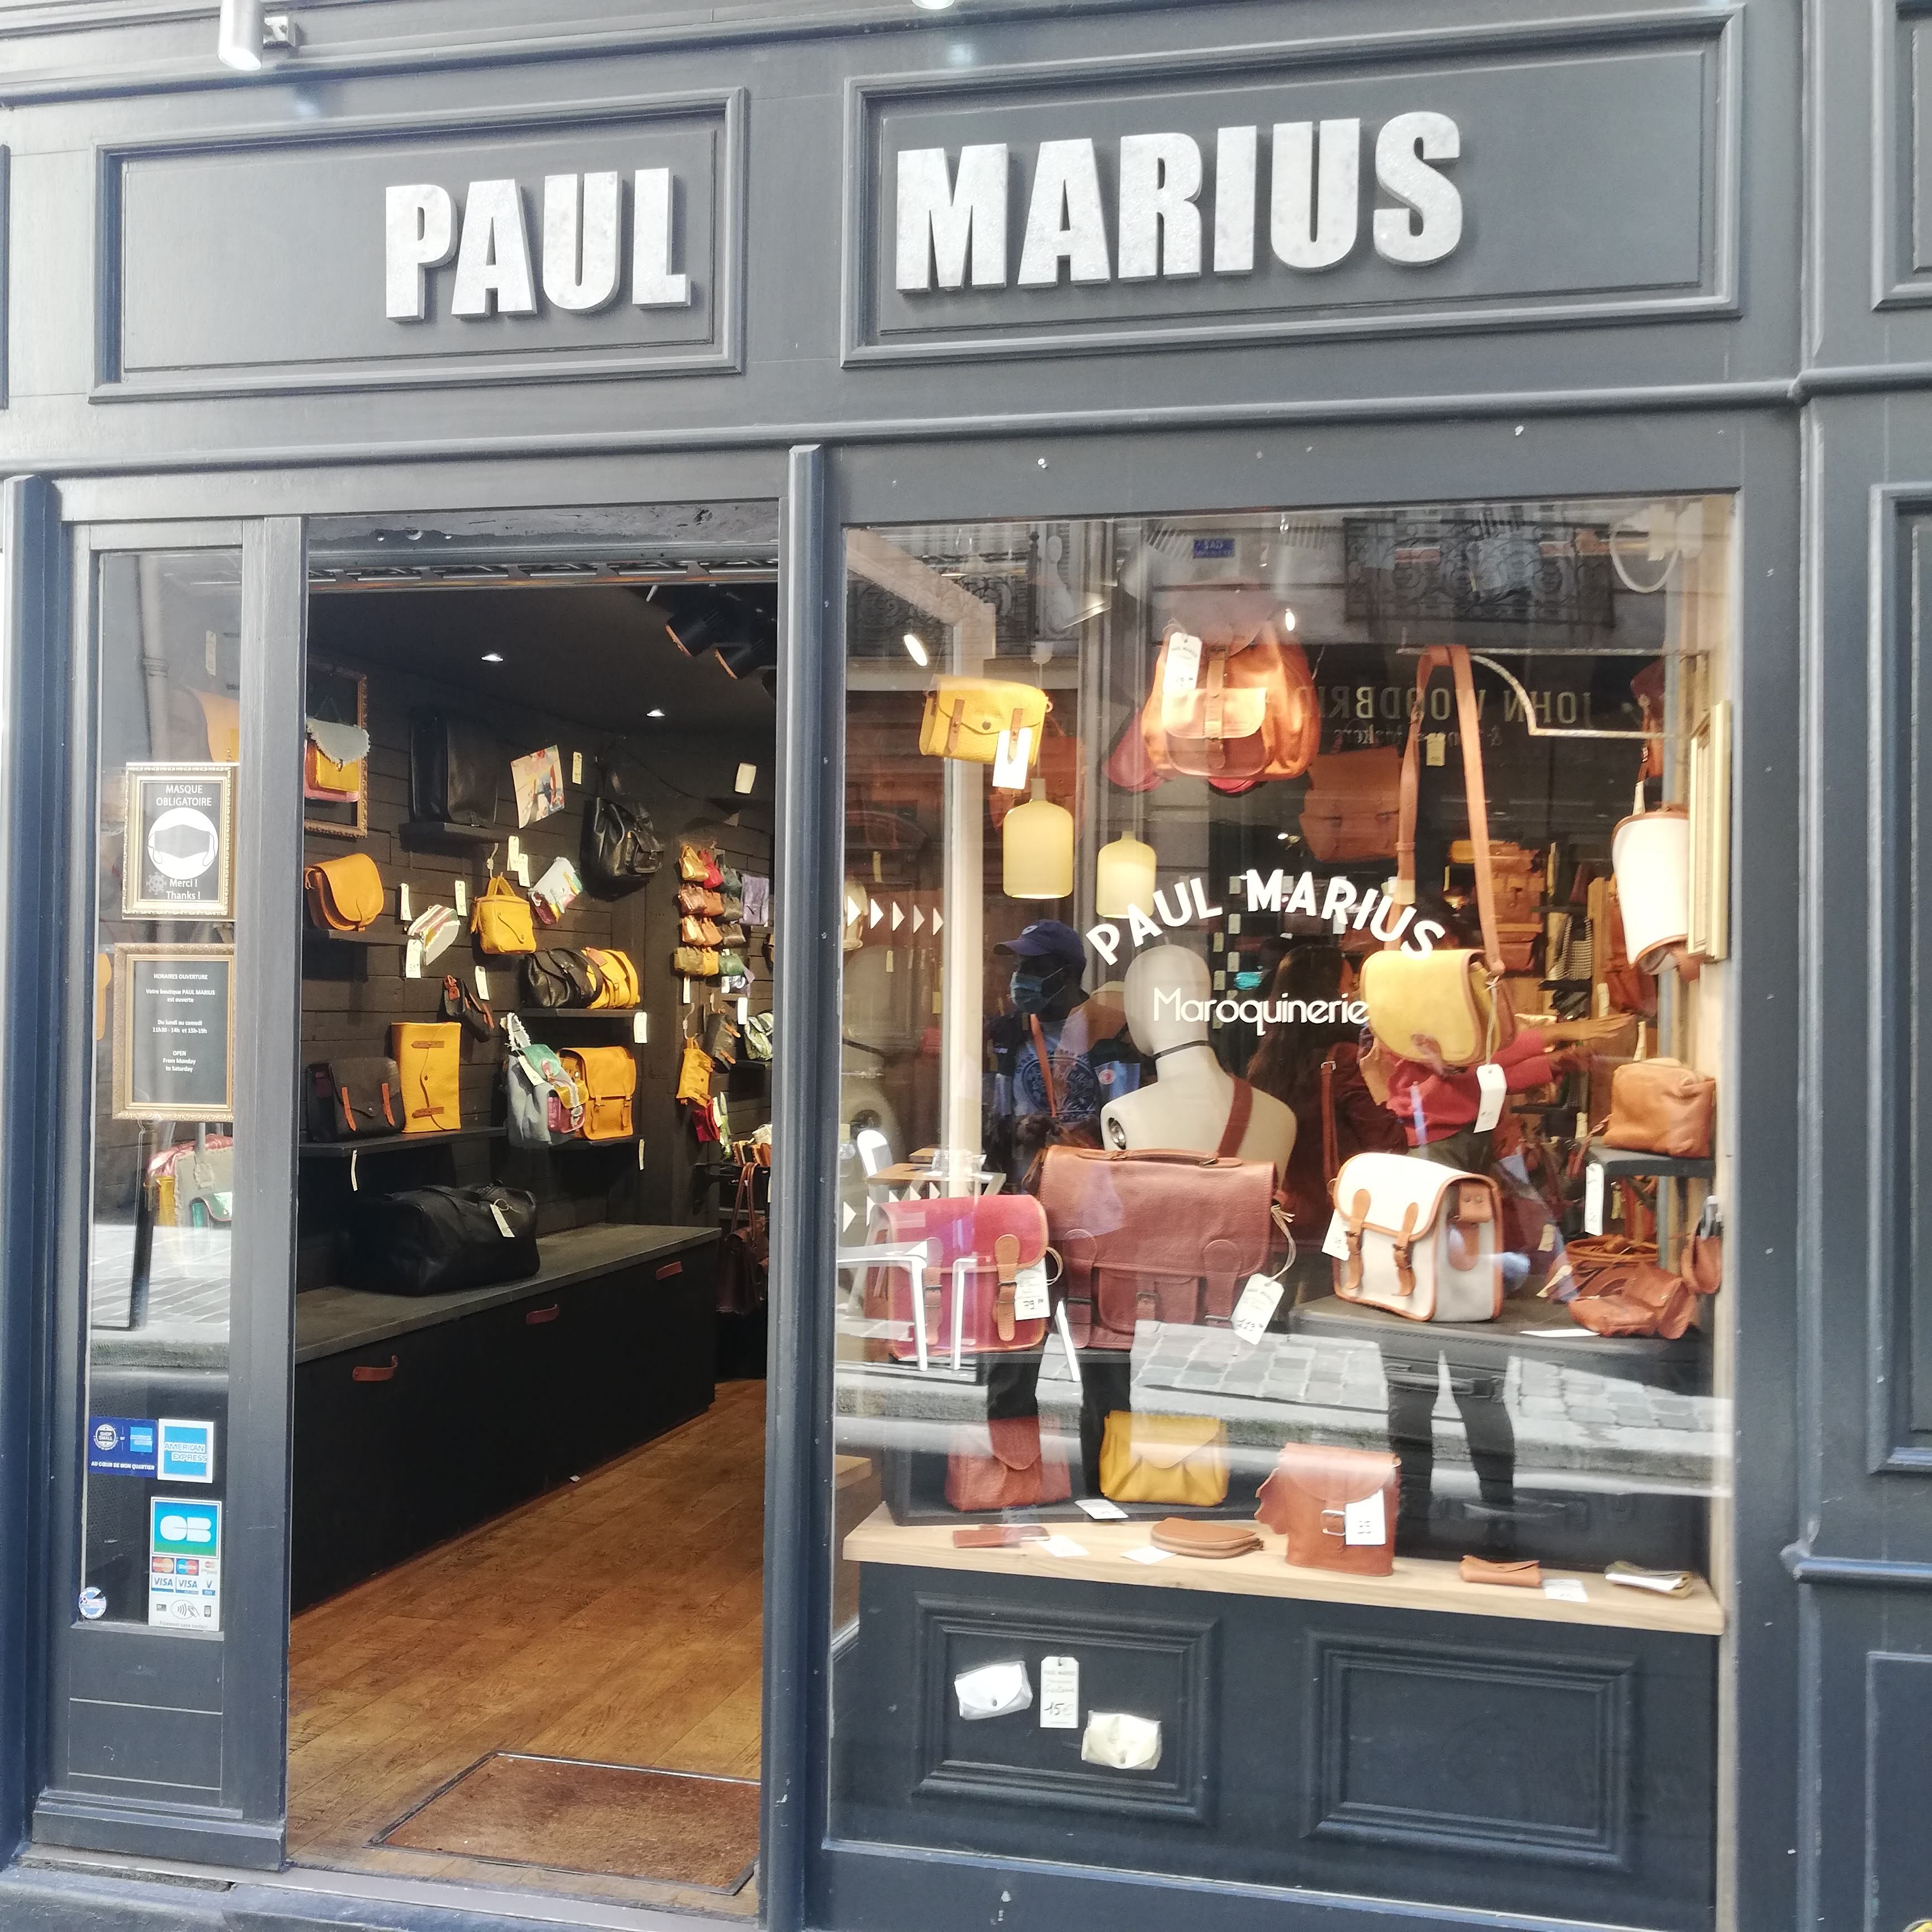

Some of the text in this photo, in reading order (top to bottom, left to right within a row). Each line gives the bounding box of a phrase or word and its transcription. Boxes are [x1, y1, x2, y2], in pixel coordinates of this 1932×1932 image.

[386, 111, 1463, 323] PAUL MARIUS
[165, 785, 203, 794] MASQUE
[156, 797, 212, 806] OBLIGATOIRE
[169, 879, 193, 888] Merci
[166, 891, 196, 899] Thanks
[1086, 869, 1446, 965] PAUL MARIUS
[1153, 988, 1370, 1035] Maroquinerie
[164, 1443, 204, 1451] AMERICAN
[173, 1453, 207, 1462] EXPRESS
[160, 1515, 212, 1542] CB
[154, 1577, 173, 1587] VISA
[179, 1580, 197, 1588] VISA
